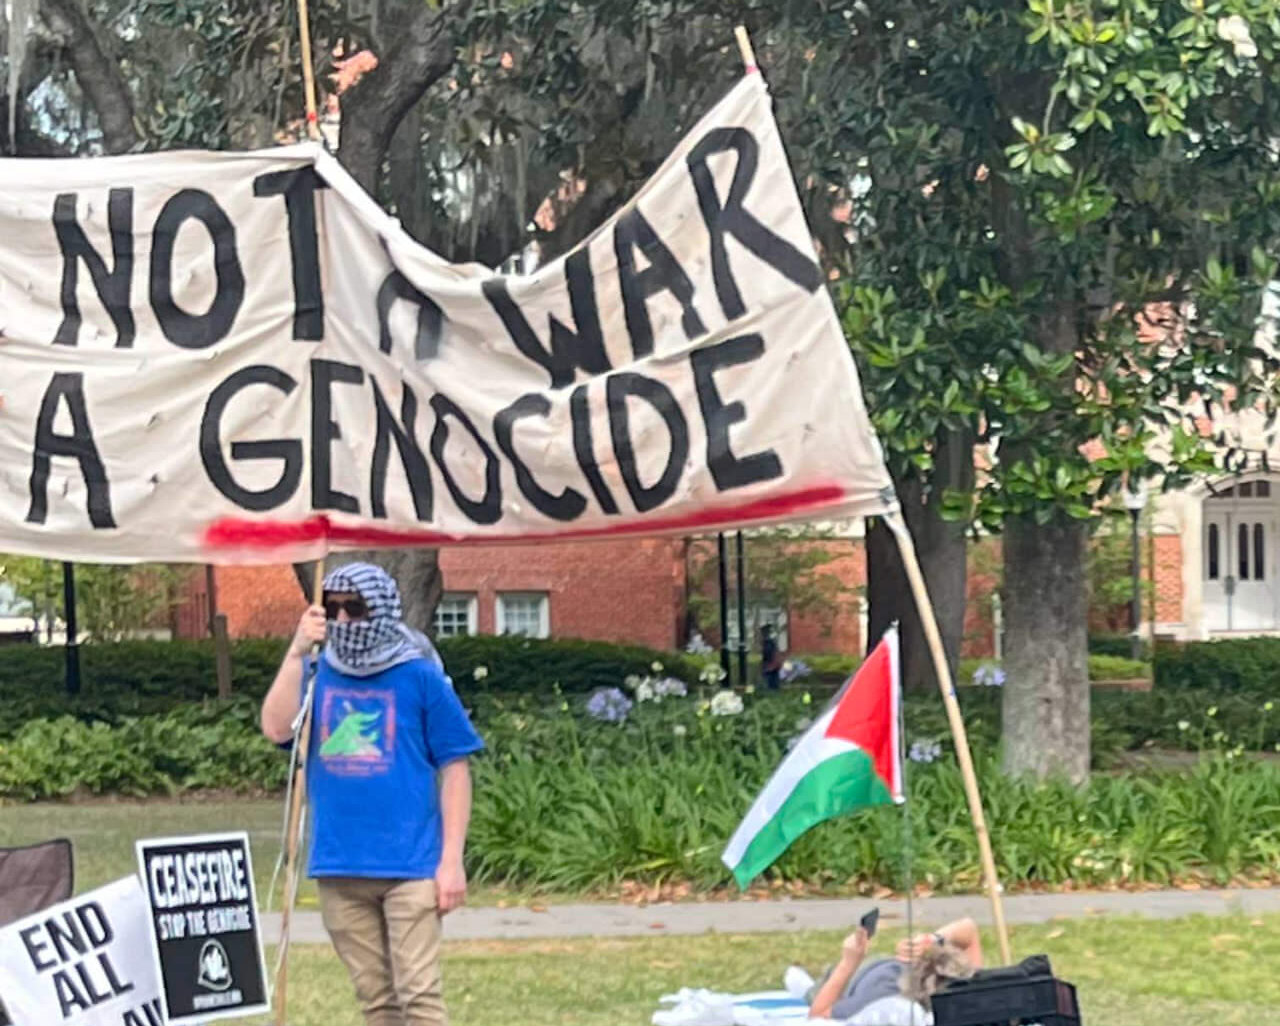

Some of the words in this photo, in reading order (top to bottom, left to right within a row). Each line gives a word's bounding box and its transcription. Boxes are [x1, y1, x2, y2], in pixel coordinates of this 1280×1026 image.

[52, 167, 329, 349] NOT
[483, 126, 825, 386] WAR
[26, 373, 116, 529] A
[200, 333, 784, 524] GENOCIDE
[150, 849, 248, 908] CEASEFIRE
[18, 900, 115, 974] END
[52, 952, 136, 1019] ALL
